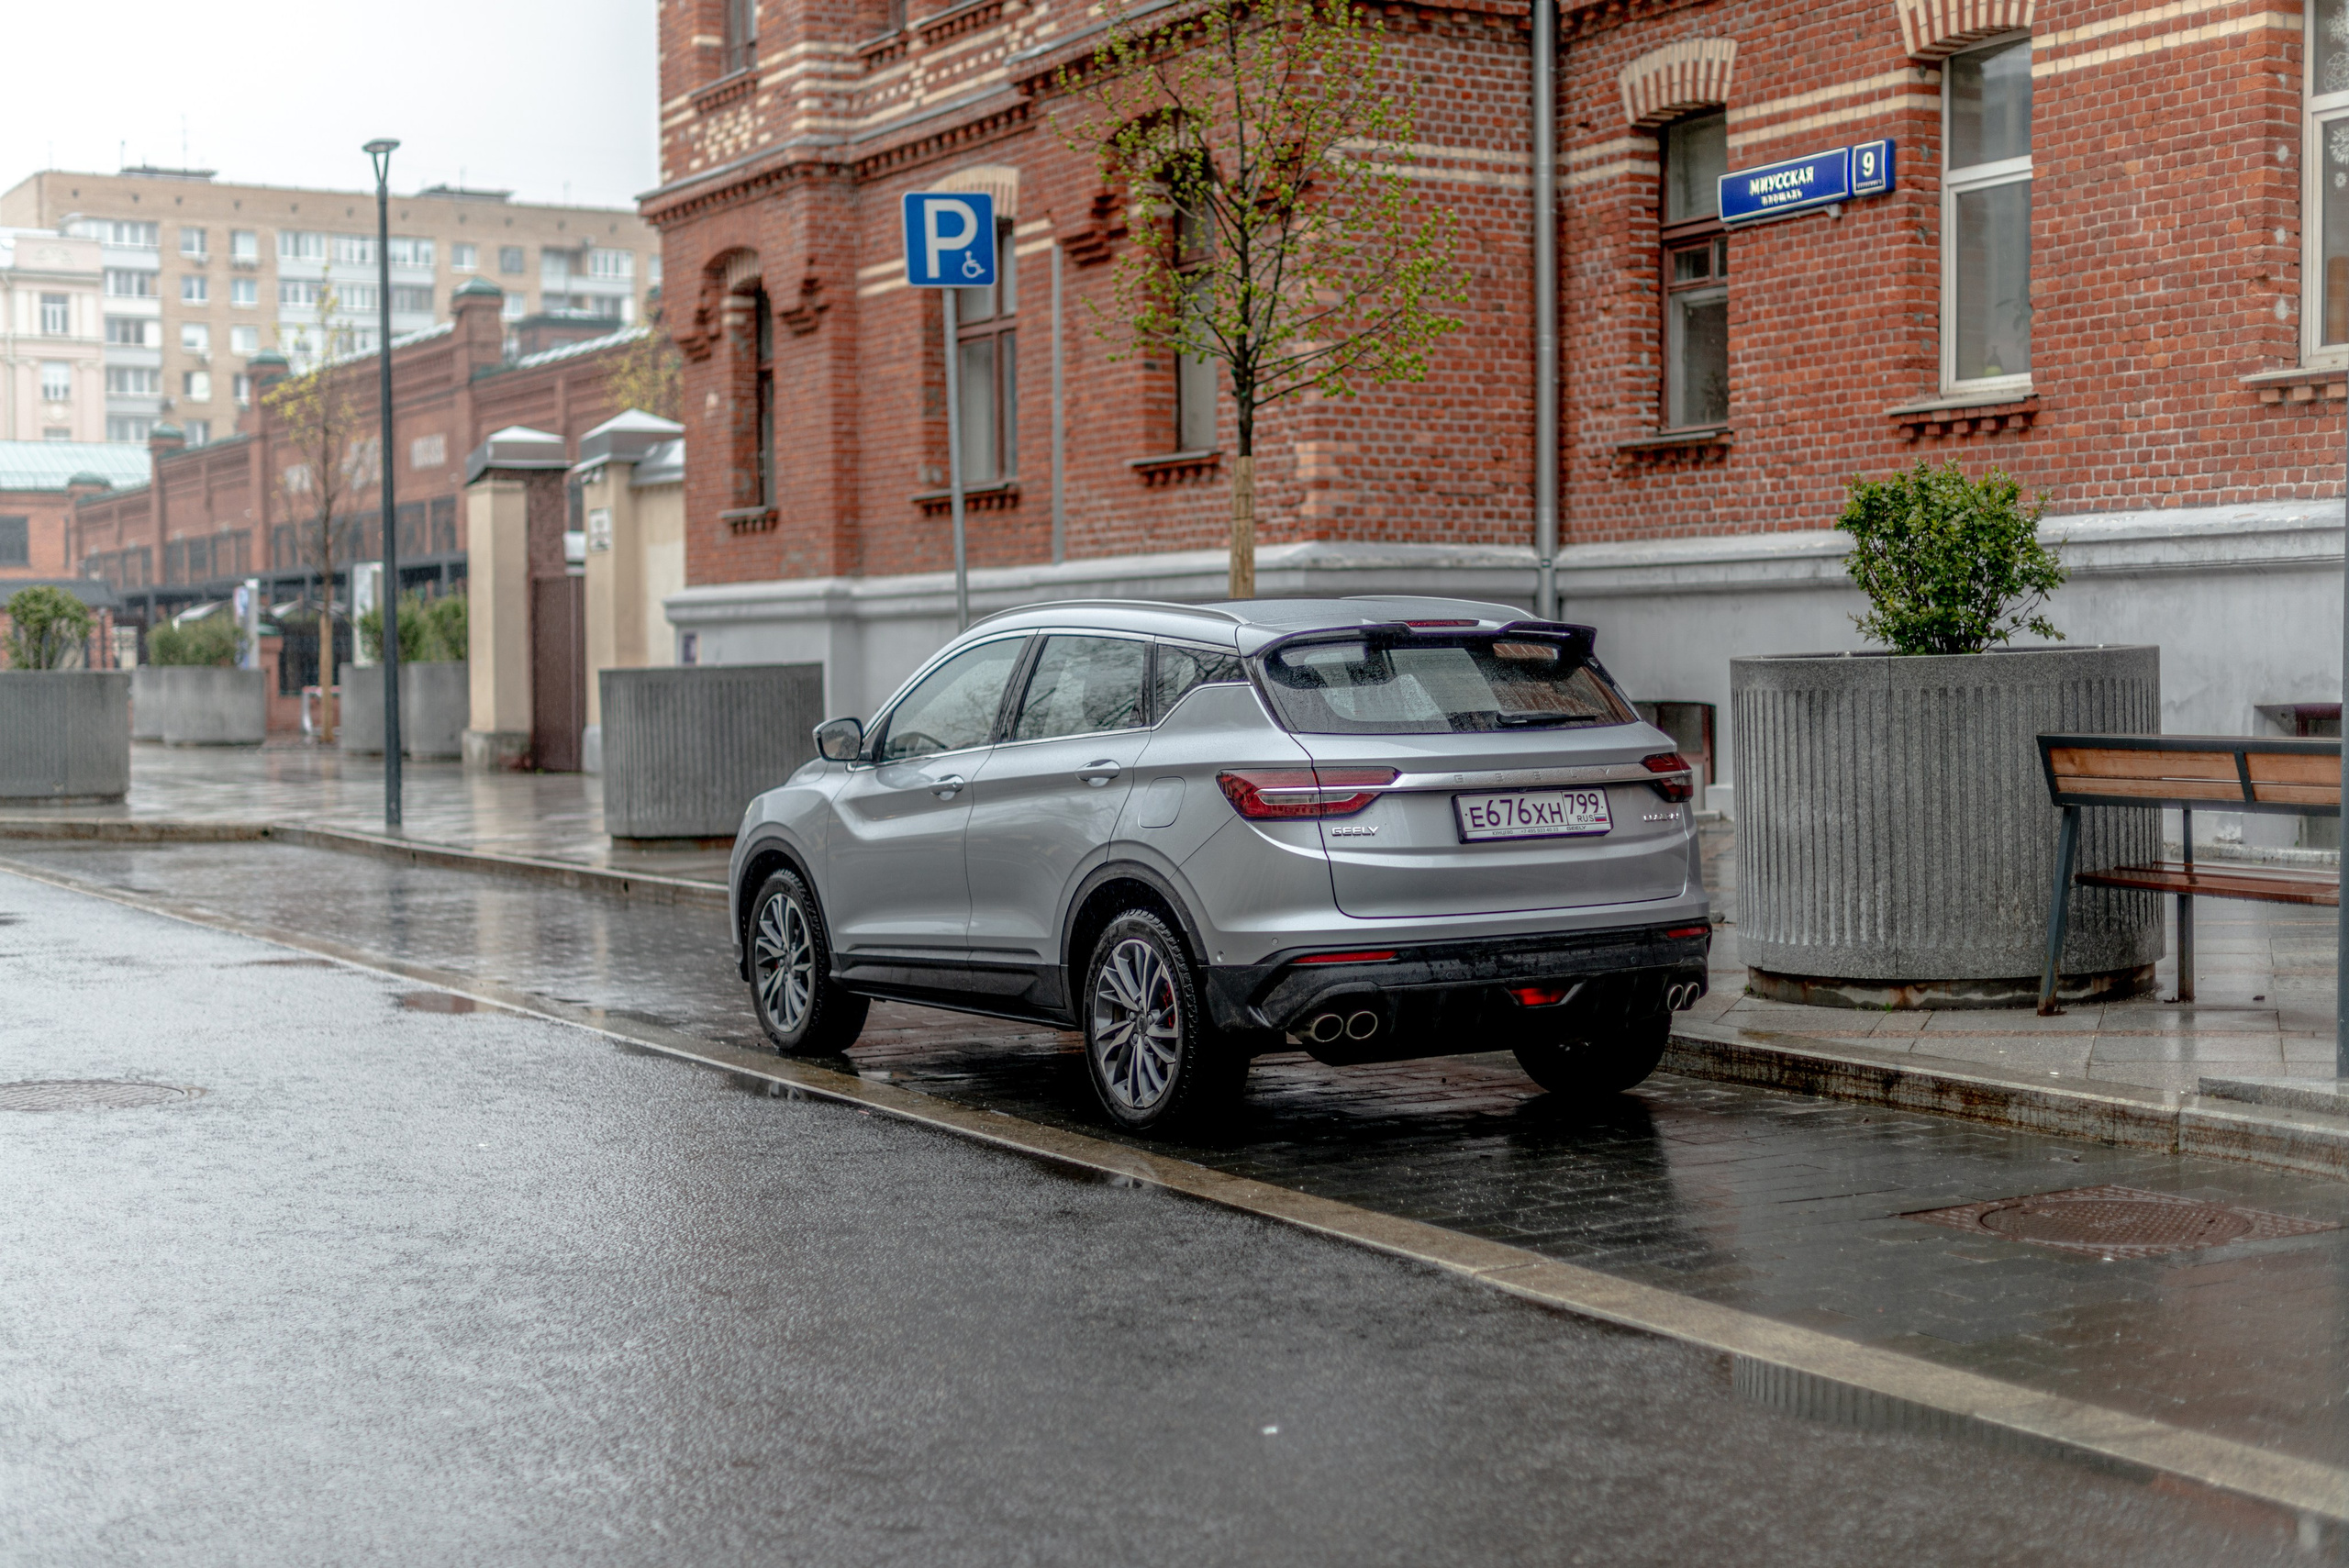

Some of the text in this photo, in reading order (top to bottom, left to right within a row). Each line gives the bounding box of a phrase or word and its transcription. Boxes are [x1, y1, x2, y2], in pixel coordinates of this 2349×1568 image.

[1862, 151, 1875, 177] 9
[1749, 166, 1814, 196] МИУССКАЯ
[1761, 188, 1803, 206] ПЛОЩАДЬ
[924, 199, 978, 278] P
[1469, 793, 1599, 828] Е676ХН 799
[1576, 815, 1595, 823] RUS
[1331, 826, 1379, 837] GEELY
